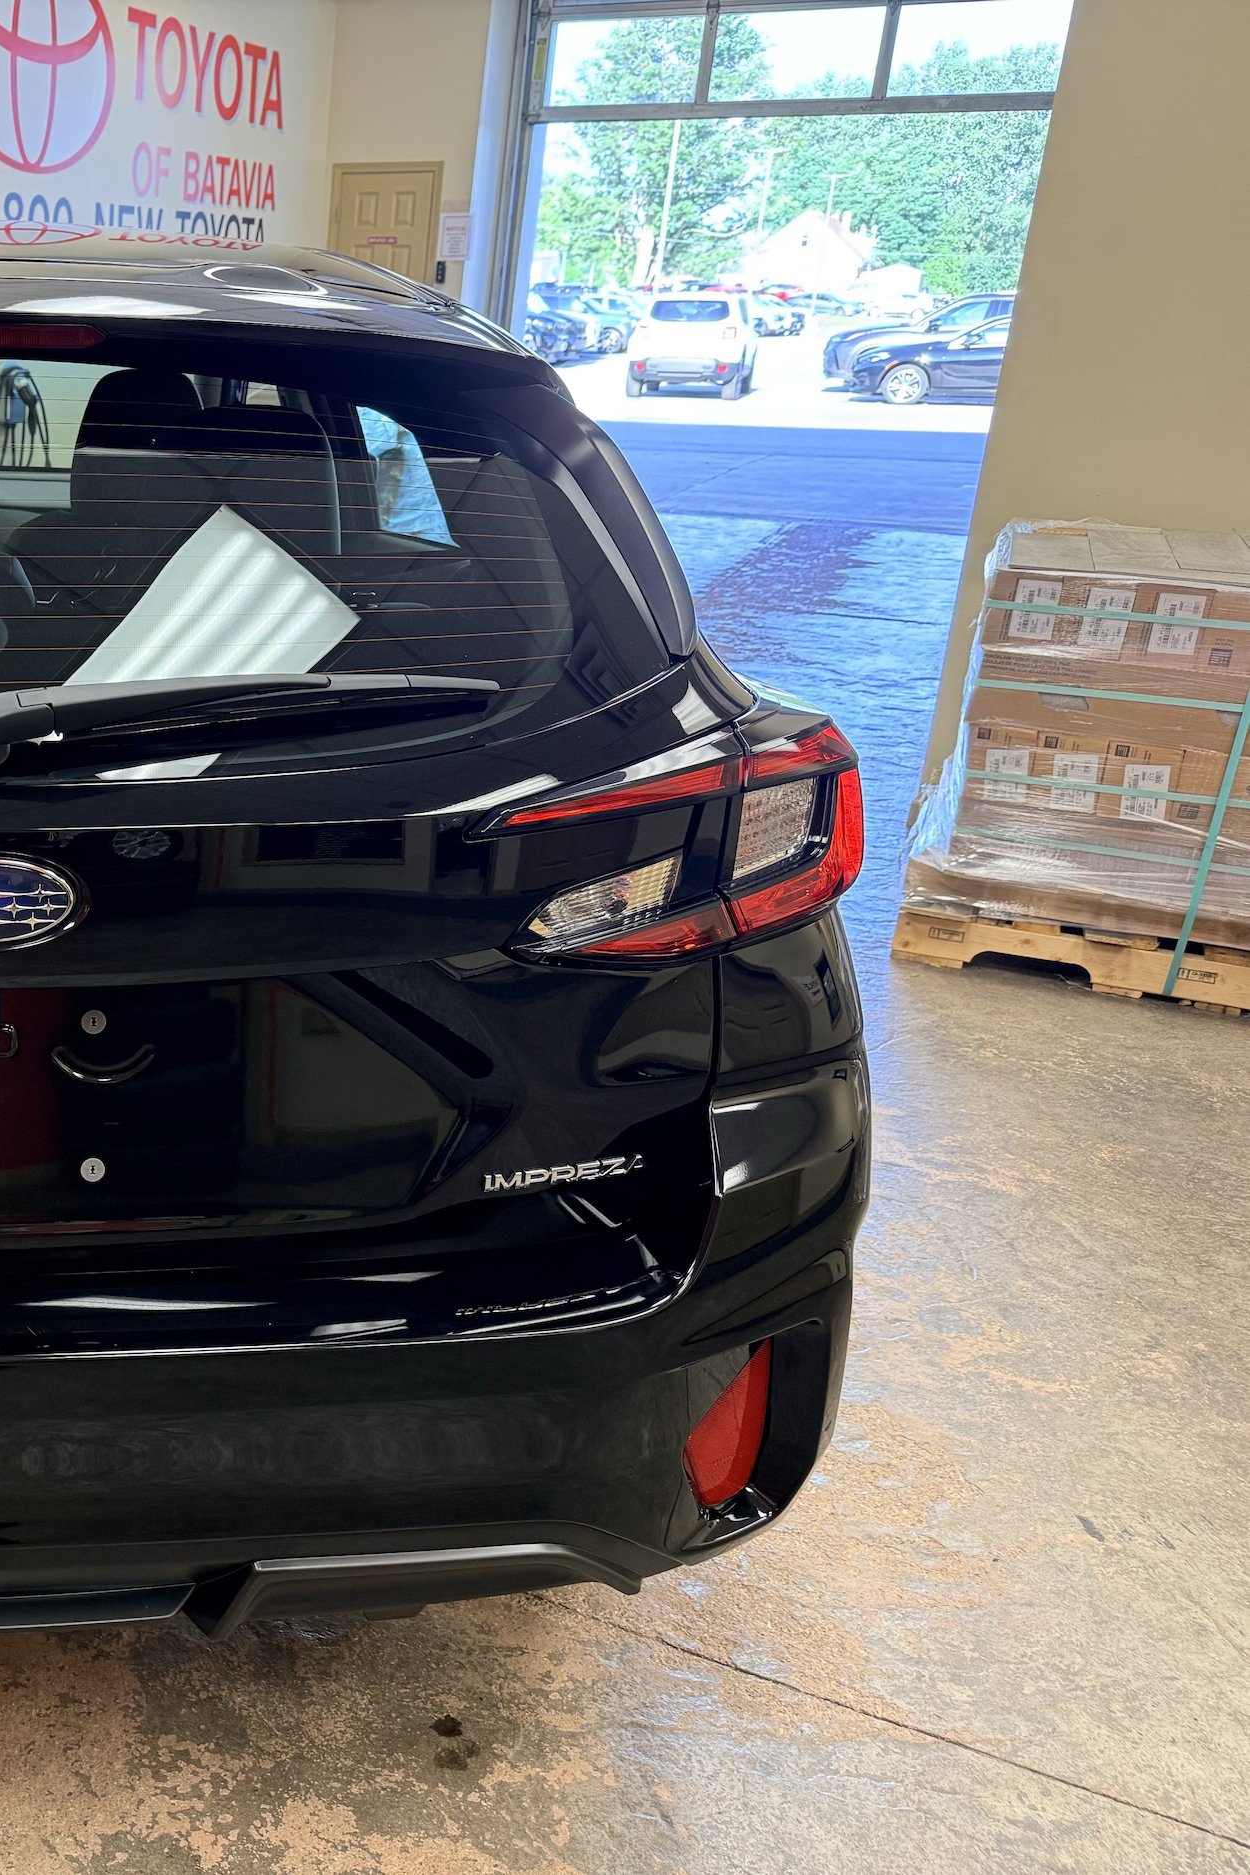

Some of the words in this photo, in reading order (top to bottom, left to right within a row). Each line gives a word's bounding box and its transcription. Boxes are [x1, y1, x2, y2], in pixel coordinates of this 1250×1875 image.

[128, 6, 283, 130] TOYOTA
[132, 142, 172, 198] OF
[183, 151, 276, 211] BATAVIA
[175, 210, 265, 243] TOYOTA
[483, 1153, 645, 1193] IMPREZA
